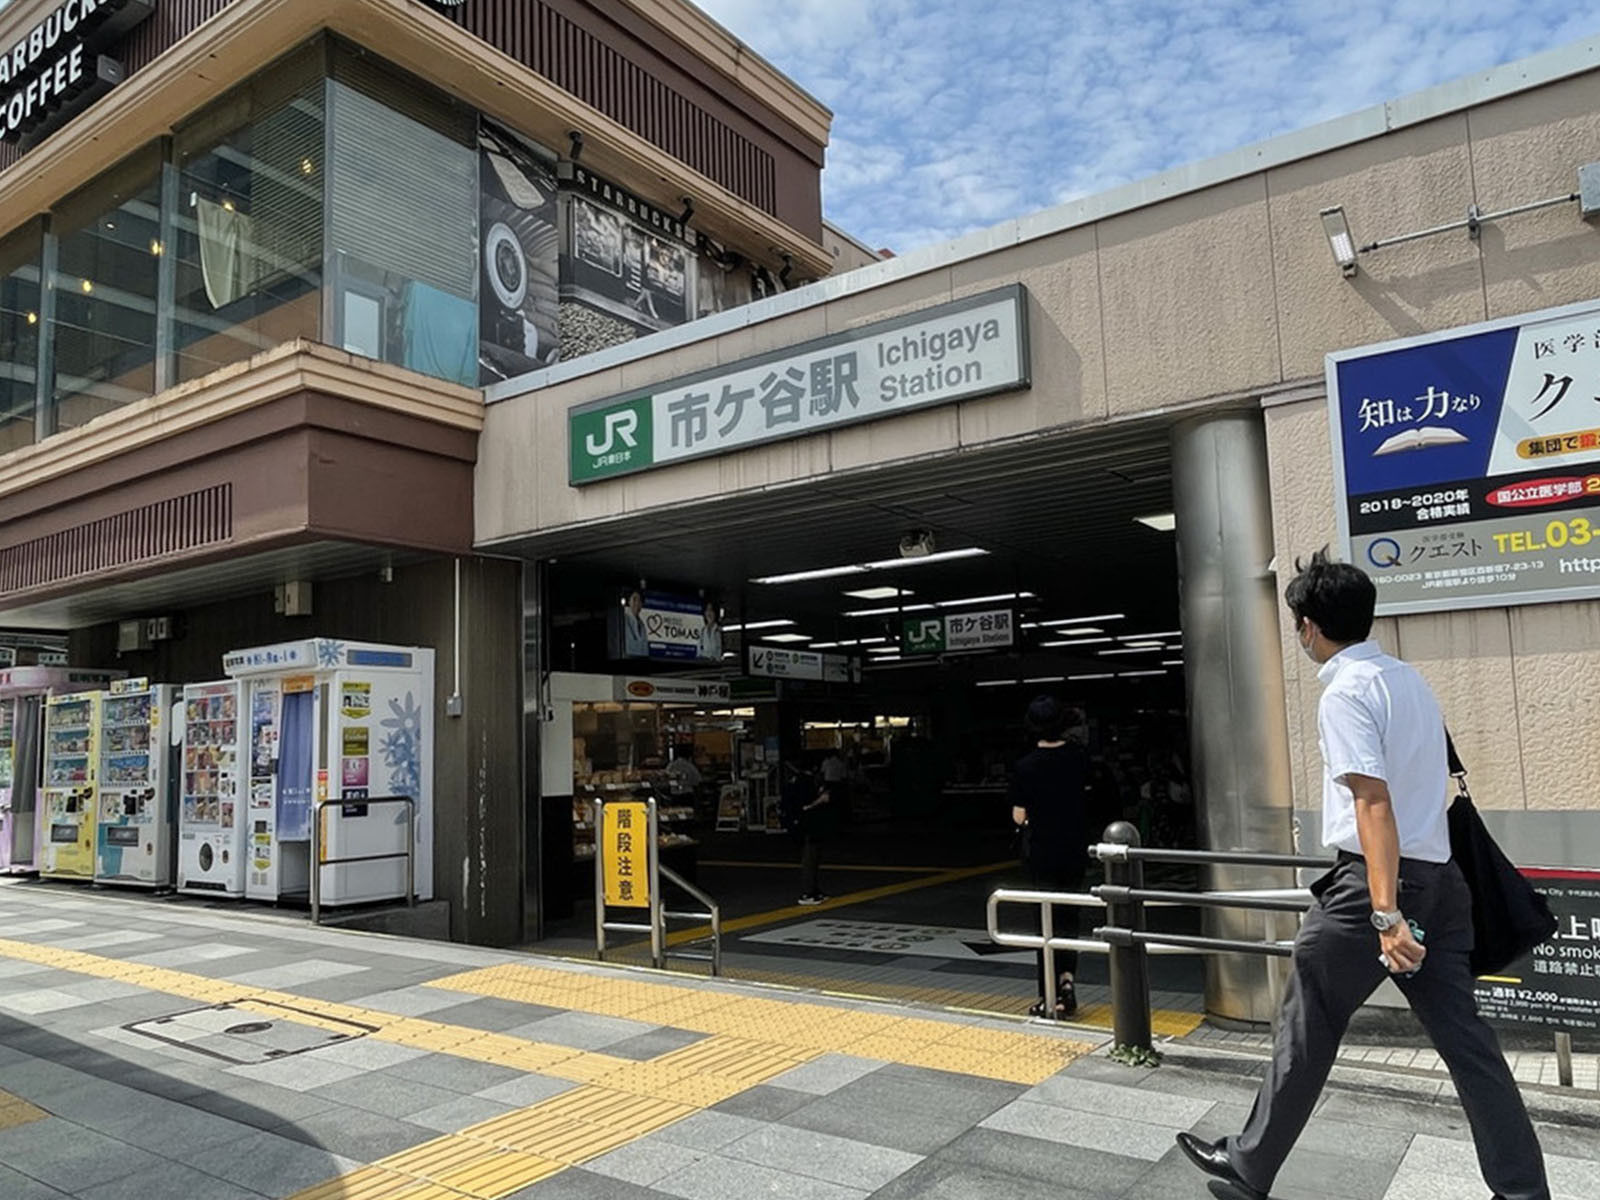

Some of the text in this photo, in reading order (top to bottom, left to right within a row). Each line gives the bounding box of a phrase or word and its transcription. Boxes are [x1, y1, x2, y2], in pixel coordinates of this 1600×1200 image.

[576, 169, 683, 238] STARBUCKS
[877, 316, 999, 368] Ichigaya
[879, 357, 983, 403] Station
[1528, 372, 1600, 422] ク
[586, 408, 638, 456] JR
[1358, 386, 1482, 432] 知は力なり
[1410, 538, 1483, 563] クエスト
[664, 625, 700, 640] TOMAS
[909, 620, 941, 643] JR
[616, 808, 635, 901] 階段注意
[1532, 942, 1556, 957] No
[1518, 989, 1559, 1003] ¥2,000
